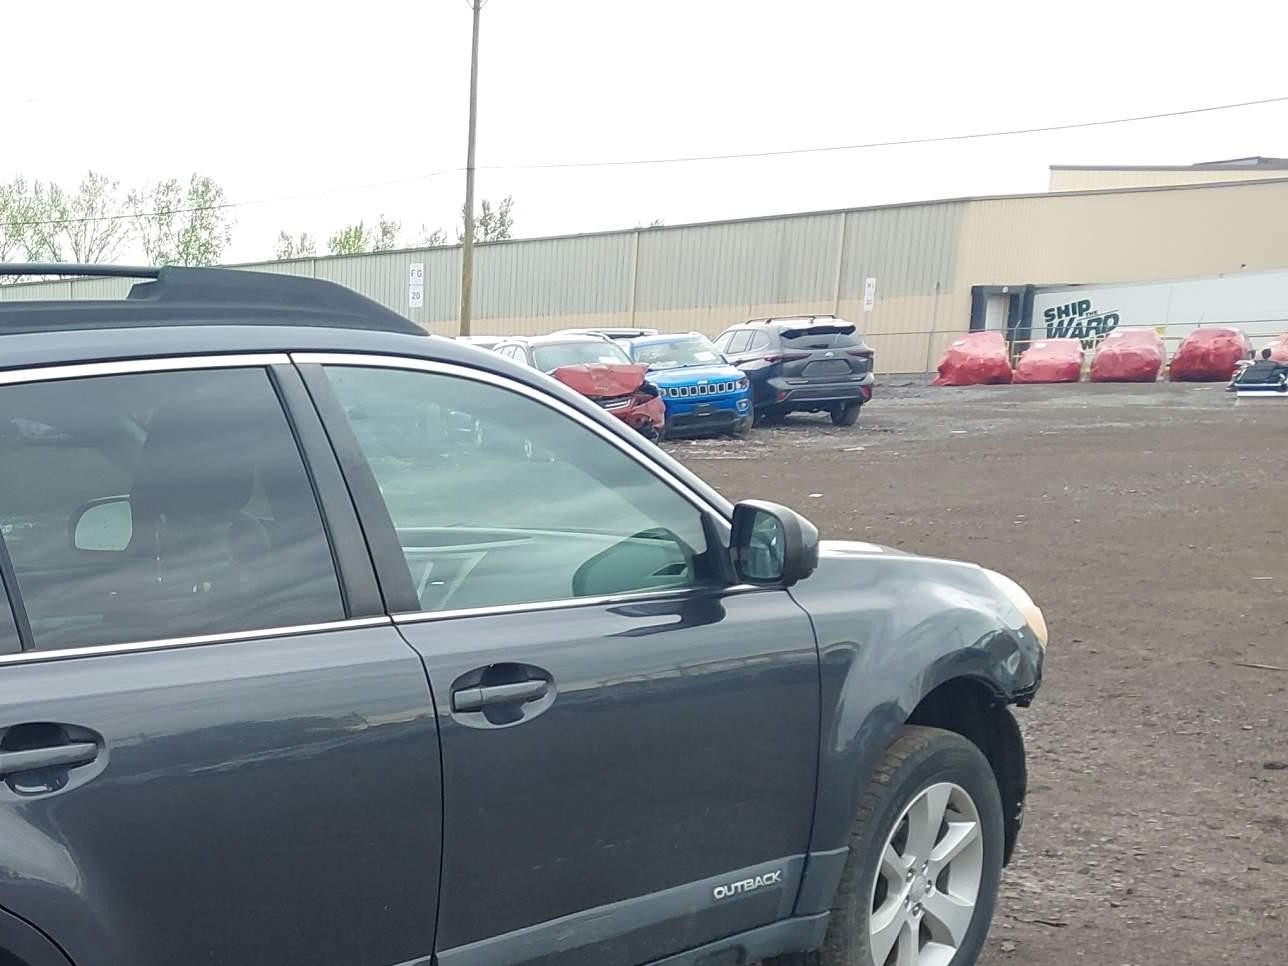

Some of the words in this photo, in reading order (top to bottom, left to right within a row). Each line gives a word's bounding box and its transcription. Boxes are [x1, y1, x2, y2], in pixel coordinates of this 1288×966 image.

[1044, 299, 1091, 322] SHIP
[1046, 313, 1120, 338] WARD
[713, 870, 782, 899] OUTBACK
